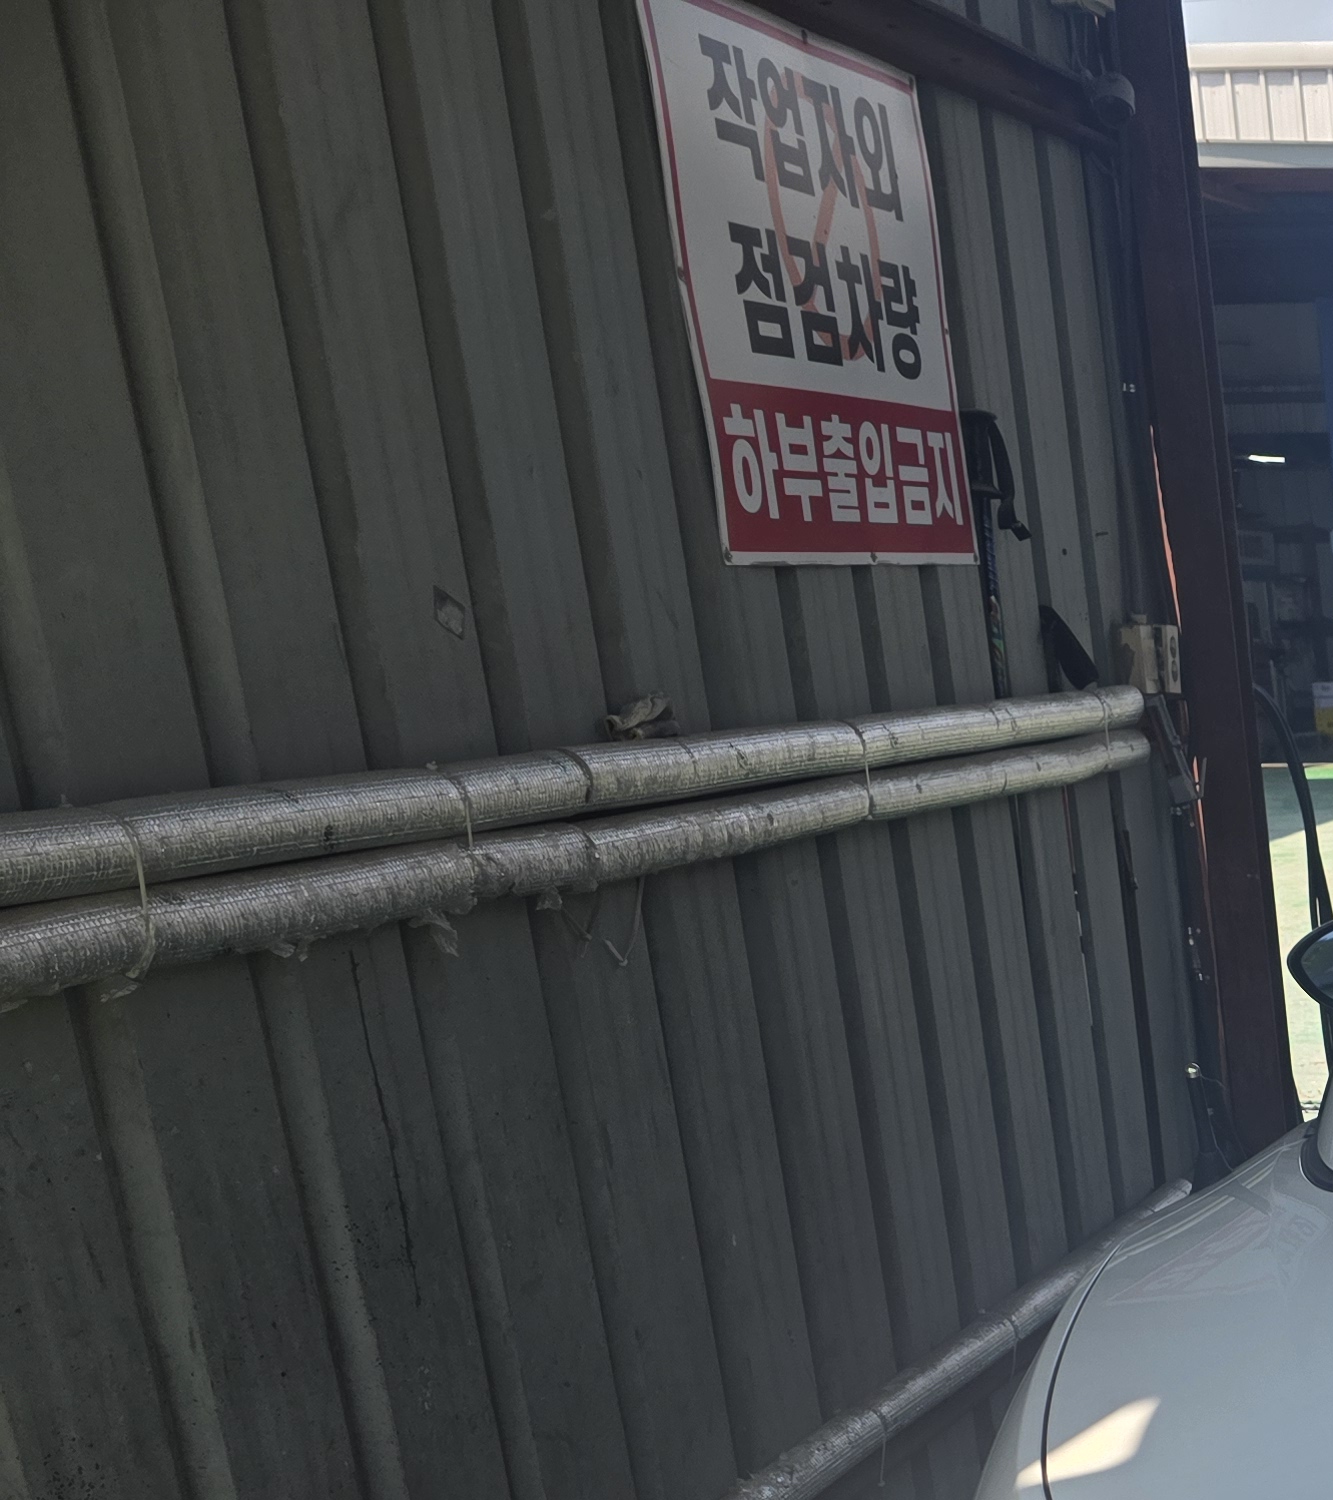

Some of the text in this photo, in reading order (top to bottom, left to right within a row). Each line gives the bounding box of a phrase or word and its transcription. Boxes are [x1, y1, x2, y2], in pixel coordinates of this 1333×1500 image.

[698, 33, 904, 222] 작업자외
[728, 221, 922, 380] 점검차량
[723, 403, 964, 526] 하부출입금지
